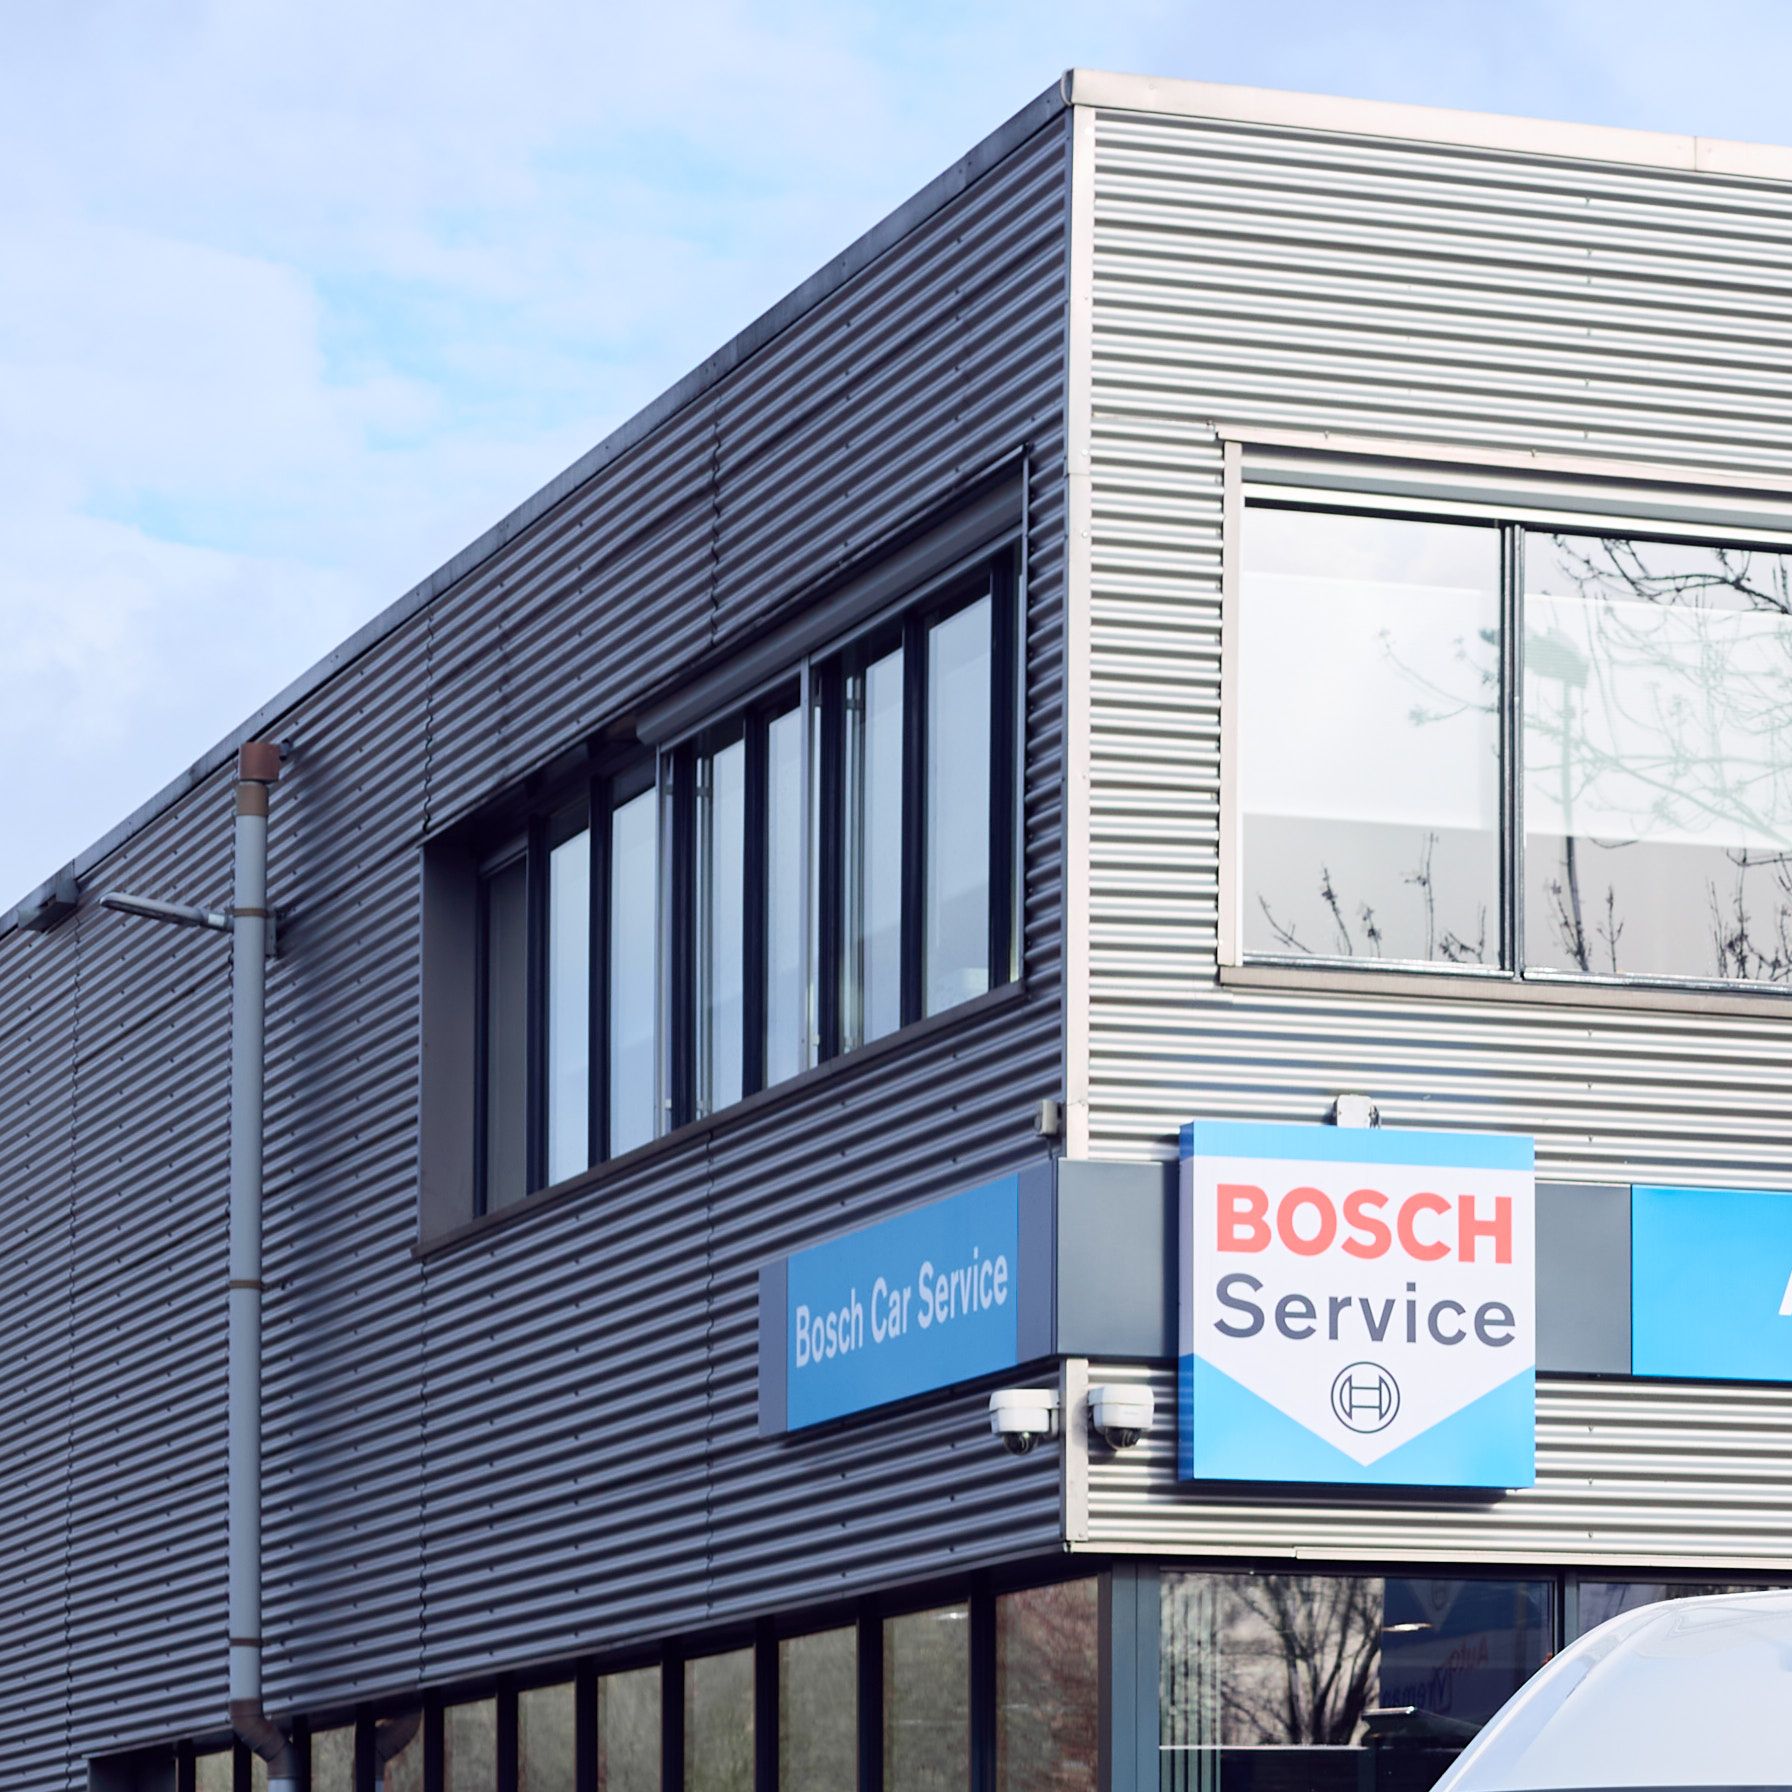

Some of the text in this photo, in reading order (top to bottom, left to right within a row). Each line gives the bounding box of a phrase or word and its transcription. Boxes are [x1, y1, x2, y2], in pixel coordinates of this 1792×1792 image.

[1216, 1184, 1513, 1264] BOSCH
[795, 1246, 1009, 1368] Bosch Car Service
[1213, 1272, 1516, 1347] Service
